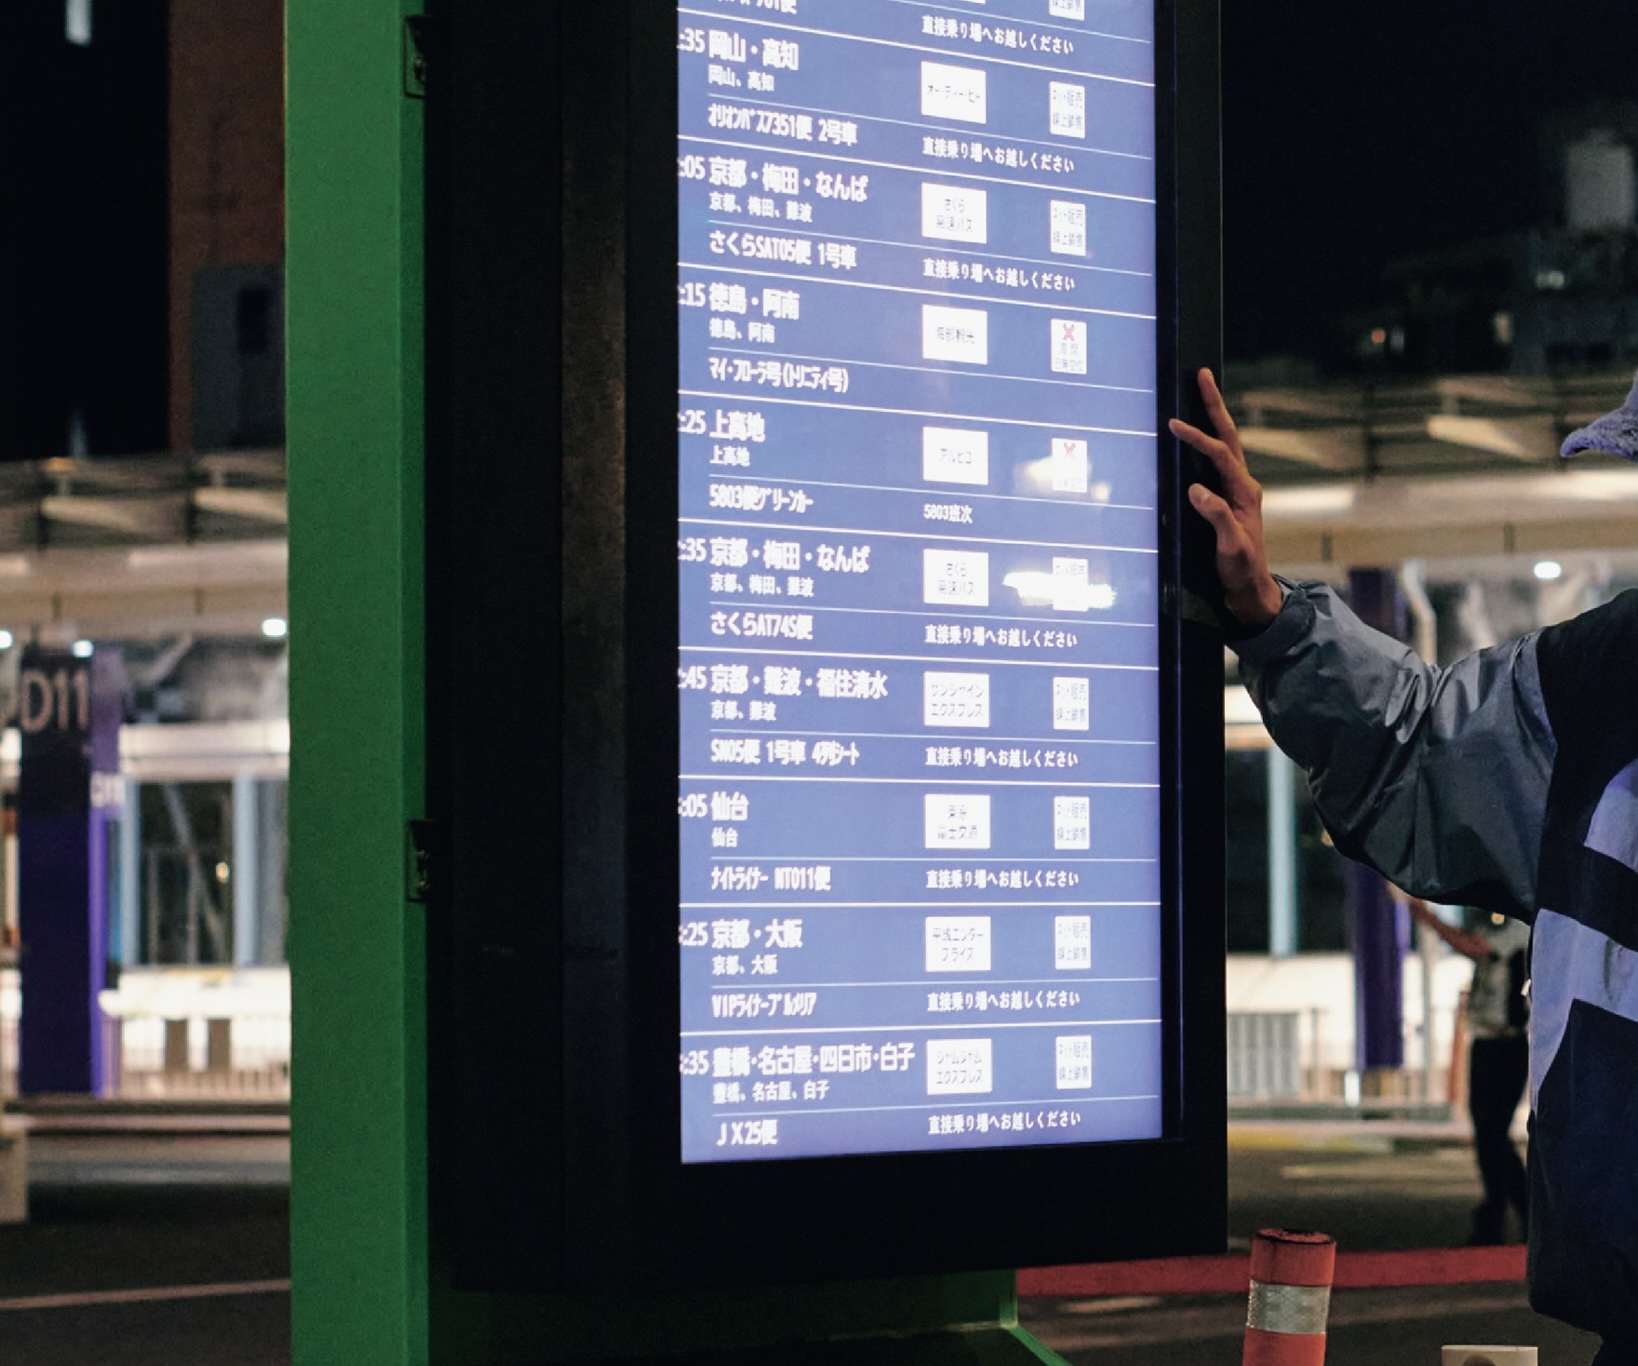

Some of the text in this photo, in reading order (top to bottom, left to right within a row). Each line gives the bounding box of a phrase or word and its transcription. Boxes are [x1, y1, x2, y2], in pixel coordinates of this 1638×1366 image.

[709, 29, 799, 70] 岡山・高知
[709, 409, 766, 443] 上高地
[709, 445, 751, 467] 上高地
[19, 668, 89, 733] D11
[711, 792, 749, 821] 仙台
[711, 827, 738, 848] 仙台
[711, 918, 803, 949] 京都・大阪
